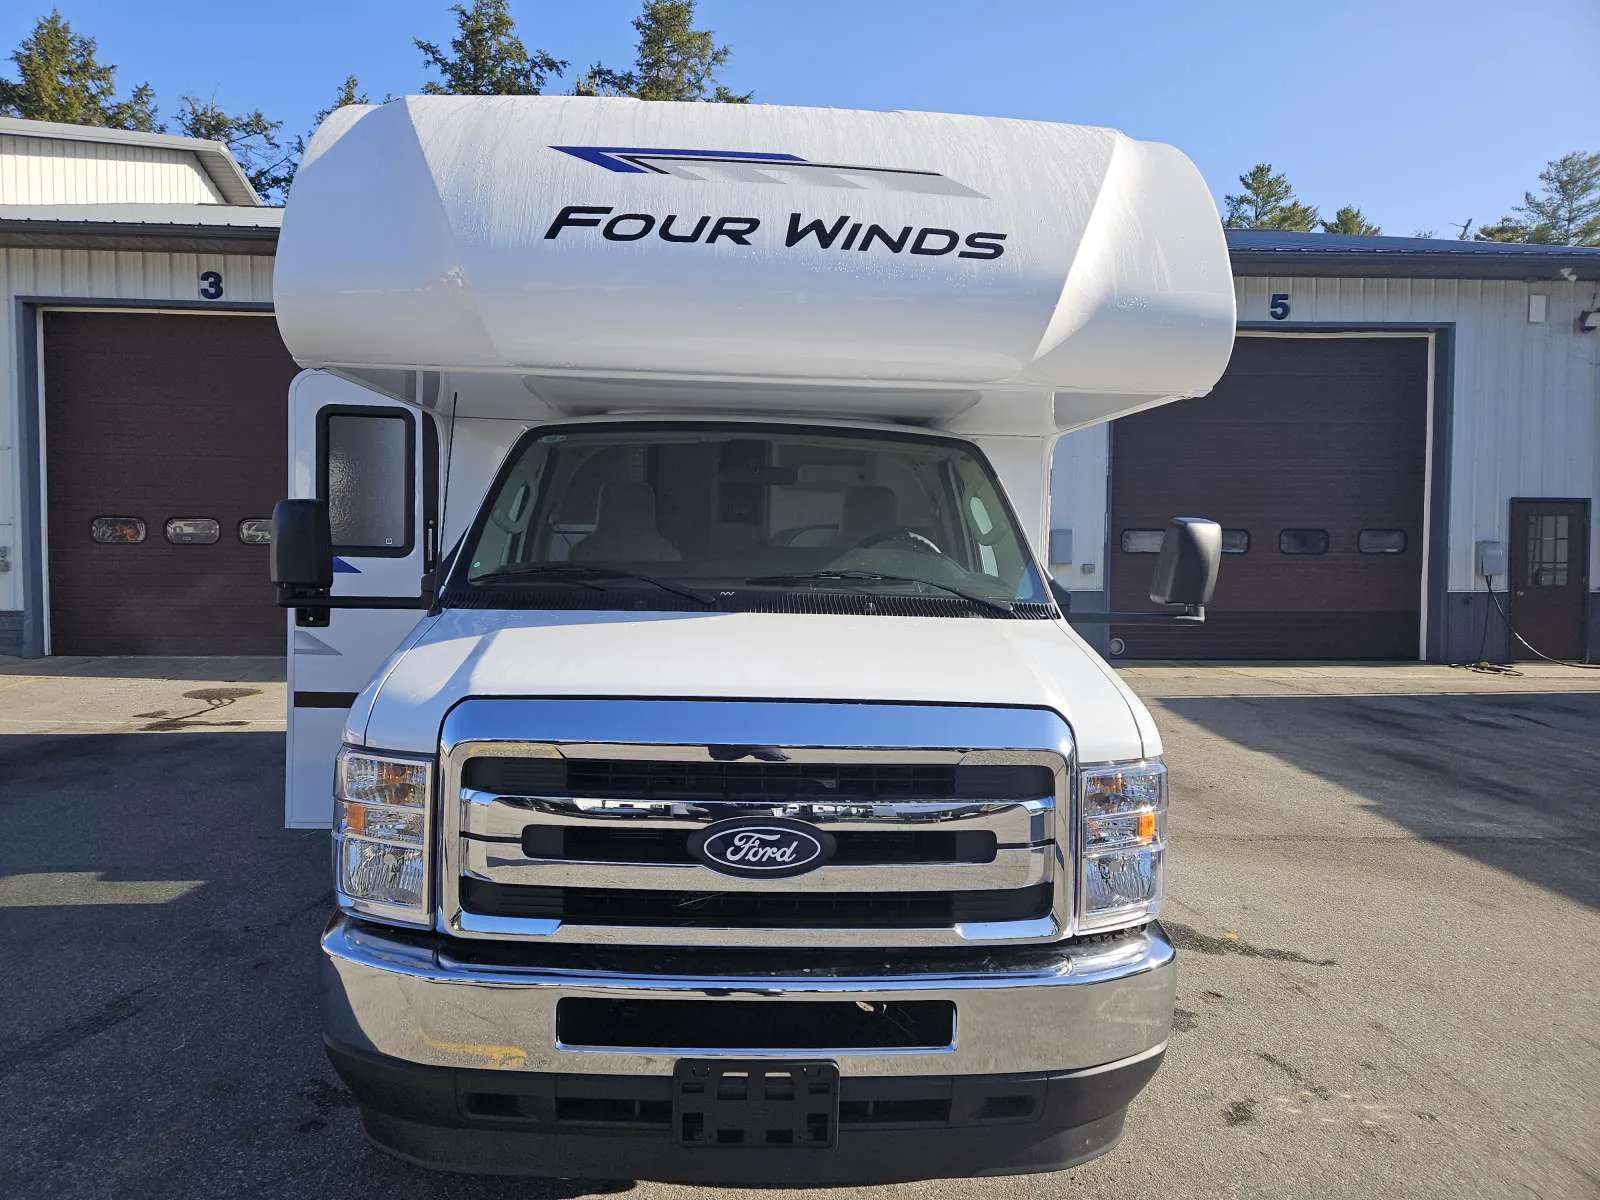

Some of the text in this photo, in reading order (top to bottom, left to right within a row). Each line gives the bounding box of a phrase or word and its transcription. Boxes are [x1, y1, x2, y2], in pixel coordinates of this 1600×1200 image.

[543, 205, 1008, 260] FOUR WINDS
[200, 270, 223, 300] 3
[1270, 293, 1290, 320] 5
[726, 832, 799, 862] Ford
